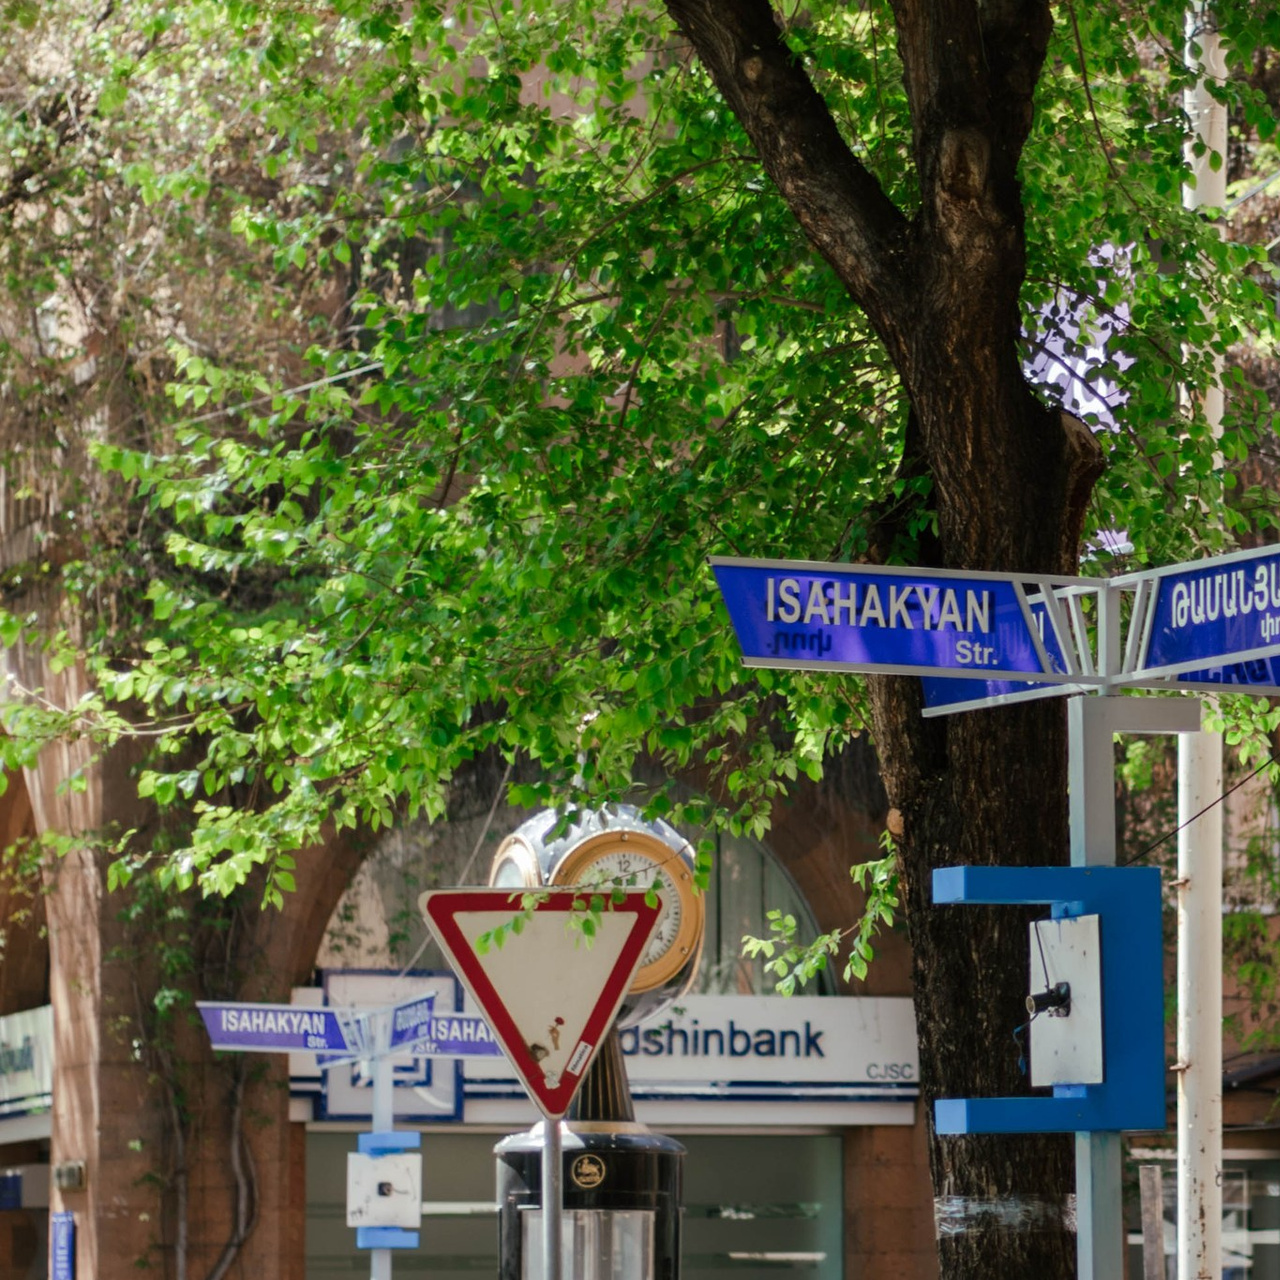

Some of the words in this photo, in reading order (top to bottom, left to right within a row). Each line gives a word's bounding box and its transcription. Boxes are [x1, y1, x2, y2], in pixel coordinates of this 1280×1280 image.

[766, 577, 989, 635] ISAHAKYAN
[955, 640, 999, 666] Str.
[613, 859, 632, 874] 12
[221, 1010, 325, 1035] ISAHAKYAN
[307, 1034, 328, 1049] Str.
[866, 1063, 914, 1081] CJSC
